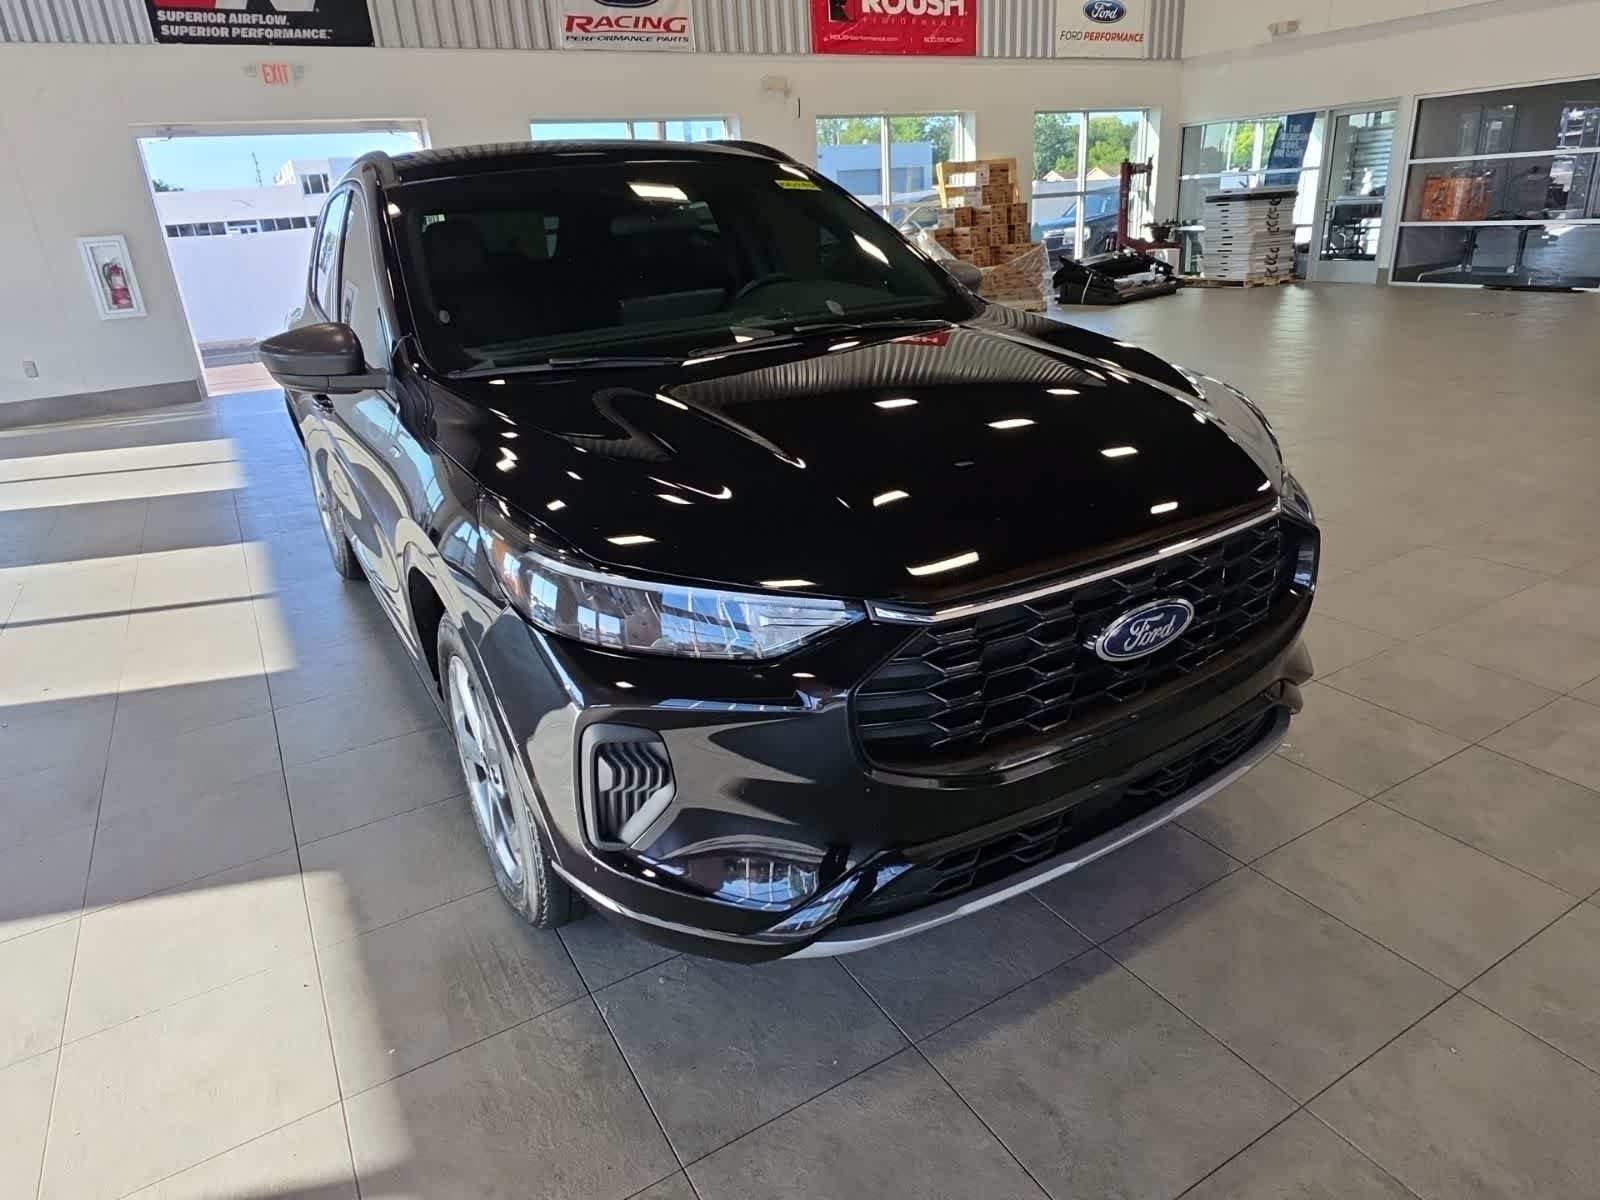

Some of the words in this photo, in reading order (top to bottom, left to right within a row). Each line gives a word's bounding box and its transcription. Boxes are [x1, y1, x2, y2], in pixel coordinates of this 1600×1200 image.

[862, 0, 964, 16] ROUSH
[1091, 1, 1118, 19] Ford
[157, 9, 226, 24] SUPERIOR
[229, 13, 290, 26] AIRFLOW.
[565, 15, 688, 33] RACING
[161, 25, 229, 38] SUPERIOR
[1060, 30, 1082, 41] FORD
[1083, 31, 1144, 42] PERFORMANCE
[262, 64, 289, 85] EXIT
[1123, 612, 1177, 652] Ford
